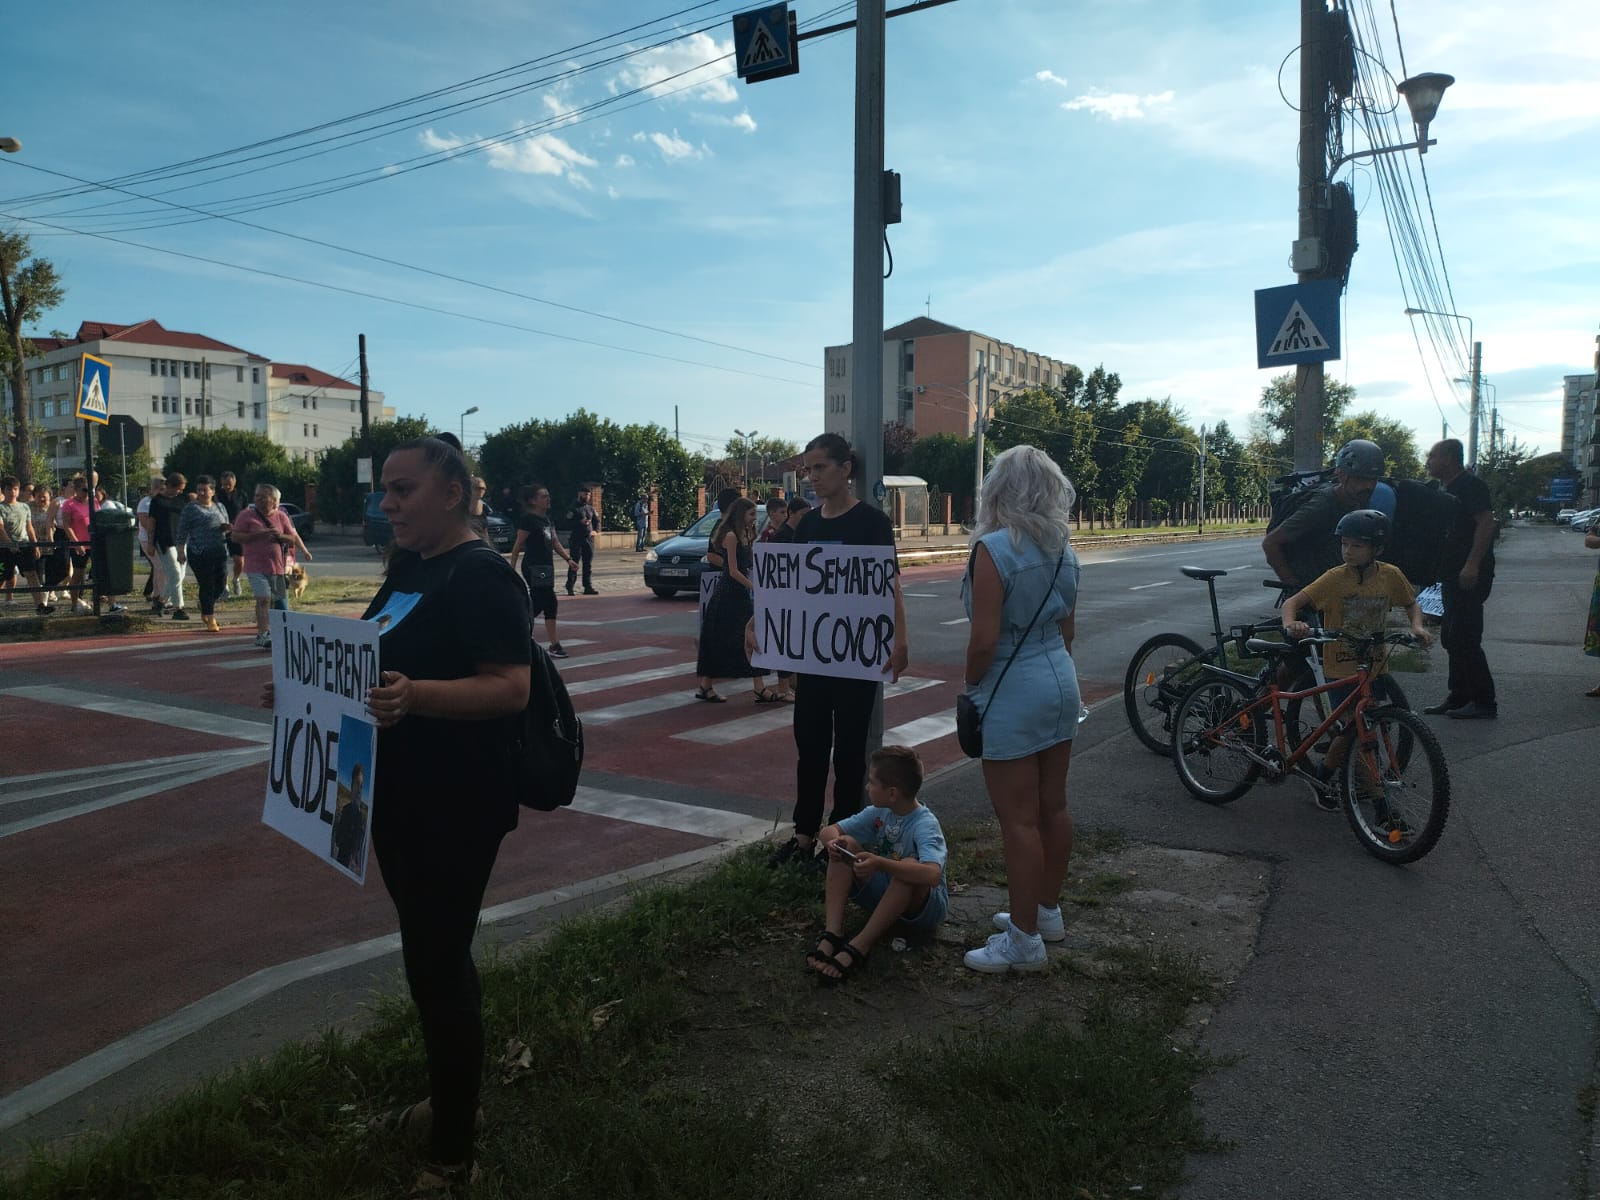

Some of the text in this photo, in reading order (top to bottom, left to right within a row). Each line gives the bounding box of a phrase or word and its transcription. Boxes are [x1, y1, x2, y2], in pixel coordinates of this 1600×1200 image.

[754, 546, 895, 598] VREM SEMAFOR
[764, 607, 895, 667] NU COVOR
